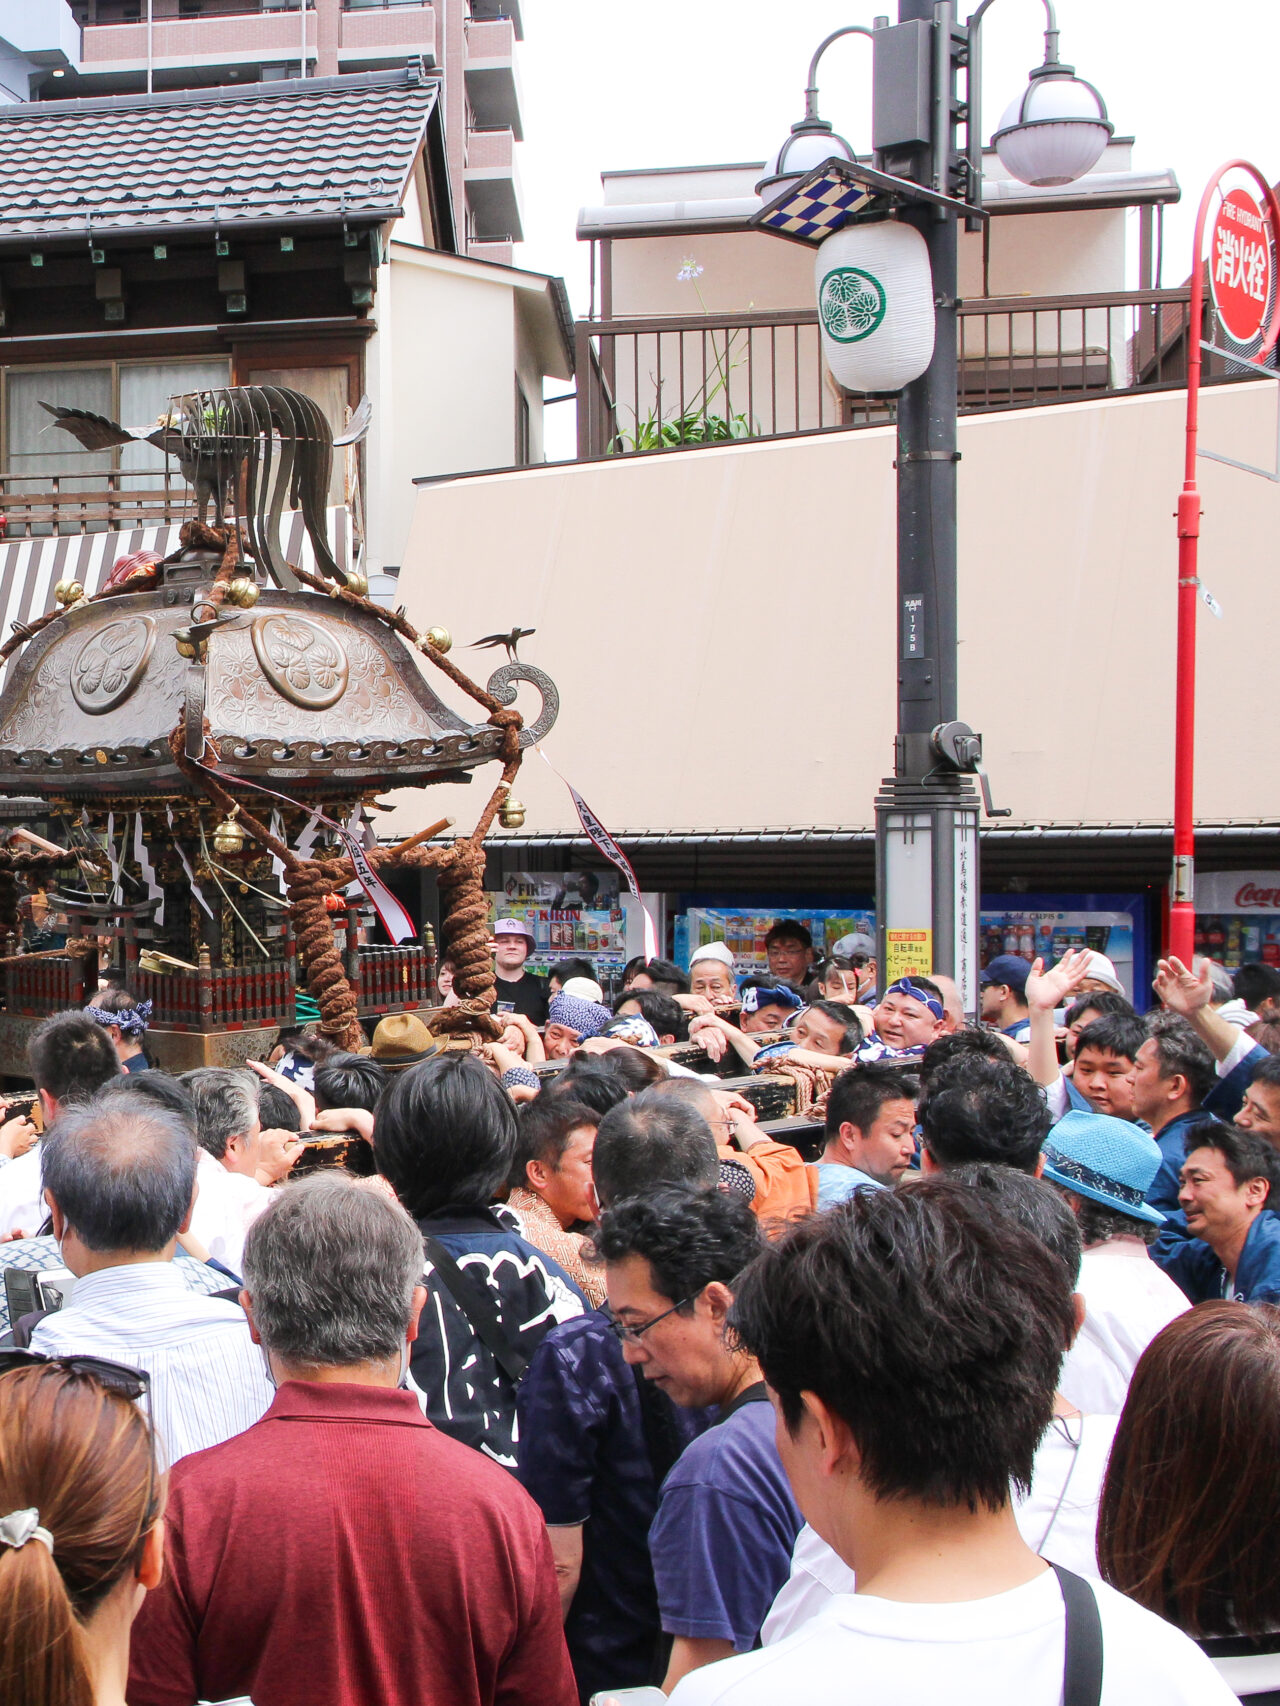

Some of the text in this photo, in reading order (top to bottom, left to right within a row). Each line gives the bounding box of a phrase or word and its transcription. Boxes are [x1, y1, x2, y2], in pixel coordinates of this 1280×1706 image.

[1223, 200, 1263, 233] FIRE HYDRANT
[1216, 226, 1265, 301] 消火栓
[539, 910, 581, 921] KIRIN
